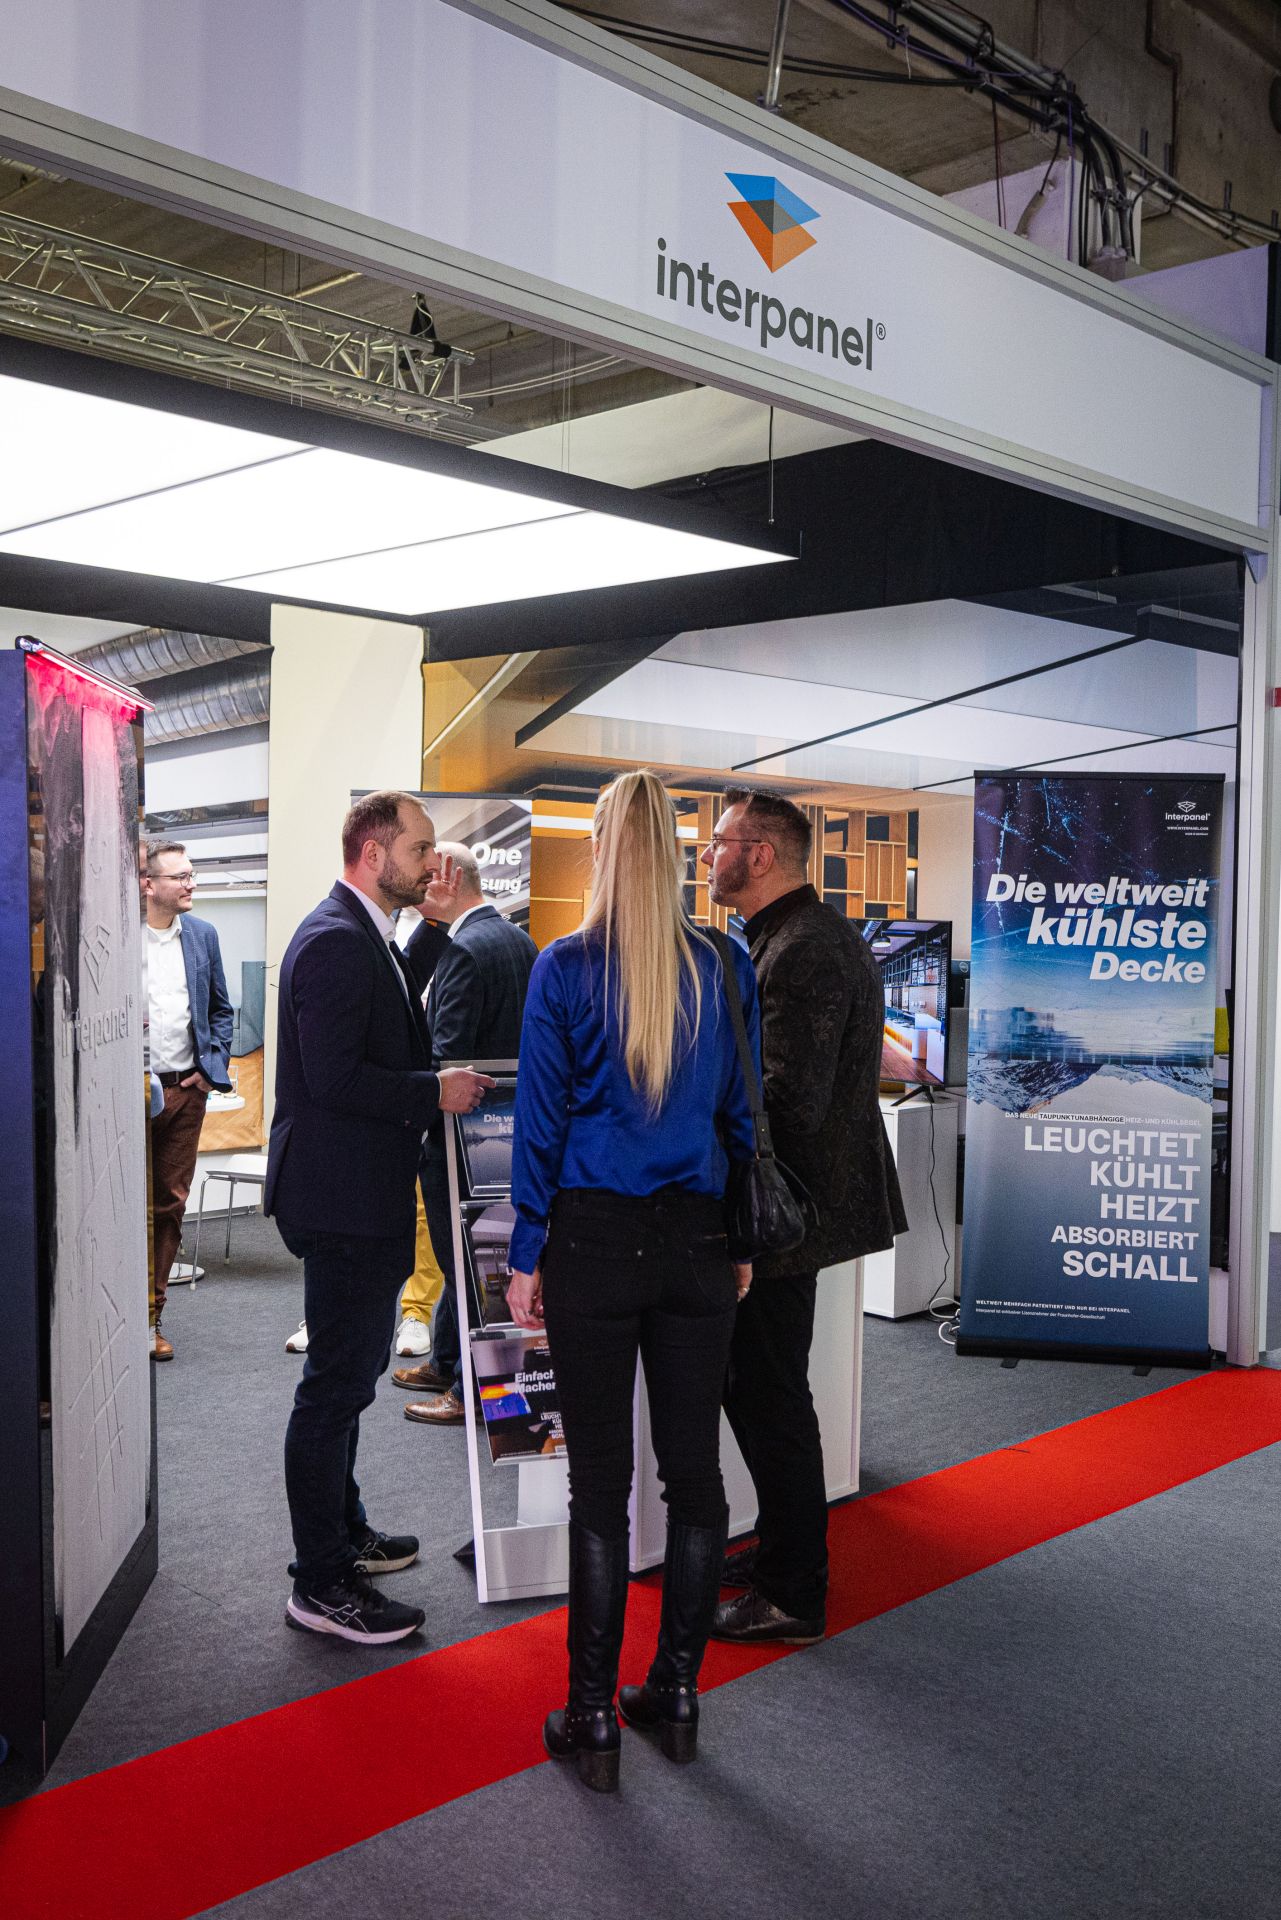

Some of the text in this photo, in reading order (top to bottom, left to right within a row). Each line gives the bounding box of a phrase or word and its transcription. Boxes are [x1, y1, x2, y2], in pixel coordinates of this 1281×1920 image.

[470, 842, 522, 866] One
[481, 878, 521, 893] sung
[986, 873, 1209, 907] Die weltweit
[1027, 907, 1207, 949] kühlste
[1089, 951, 1206, 983] Decke
[484, 1114, 502, 1123] Die
[1040, 1113, 1124, 1123] TAUPUNKTUNABHÄNGIGE
[1024, 1125, 1201, 1158] LEUCHTET
[1090, 1156, 1200, 1190] KÜHLT
[1100, 1193, 1200, 1223] HEIZT
[1051, 1225, 1199, 1250] ABSORBIERT
[1062, 1250, 1198, 1283] SCHALL
